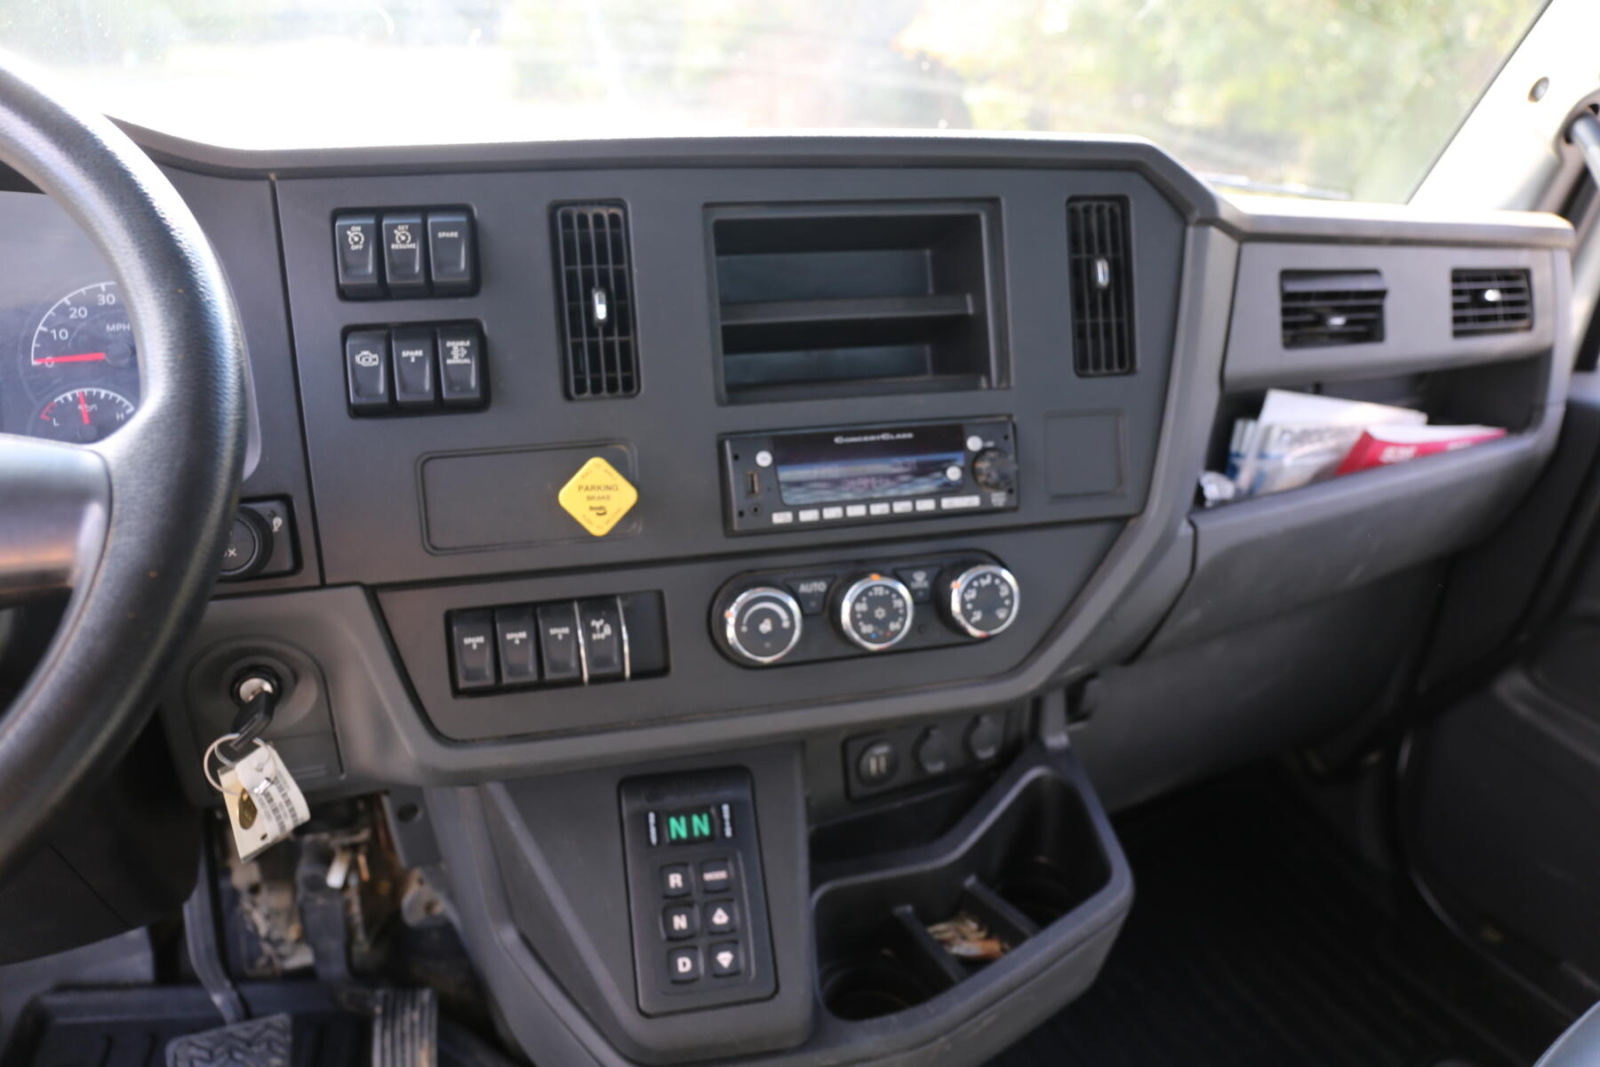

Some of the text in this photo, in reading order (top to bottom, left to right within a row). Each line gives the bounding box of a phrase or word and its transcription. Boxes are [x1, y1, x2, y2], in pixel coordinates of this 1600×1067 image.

[97, 293, 116, 306] 30
[68, 306, 88, 320] 20
[106, 322, 131, 333] MPH
[49, 328, 69, 341] 10
[402, 349, 423, 357] SPARE
[52, 417, 60, 427] L
[115, 411, 125, 422] H
[577, 484, 619, 493] PARKING
[586, 494, 611, 502] BRAKE
[798, 581, 828, 594] AUTO
[872, 586, 884, 595] 72
[506, 631, 527, 639] SPARE
[549, 627, 569, 635] SPARE
[463, 636, 484, 644] SPARE
[668, 872, 683, 890] R
[672, 913, 688, 931] N
[676, 957, 693, 973] D
